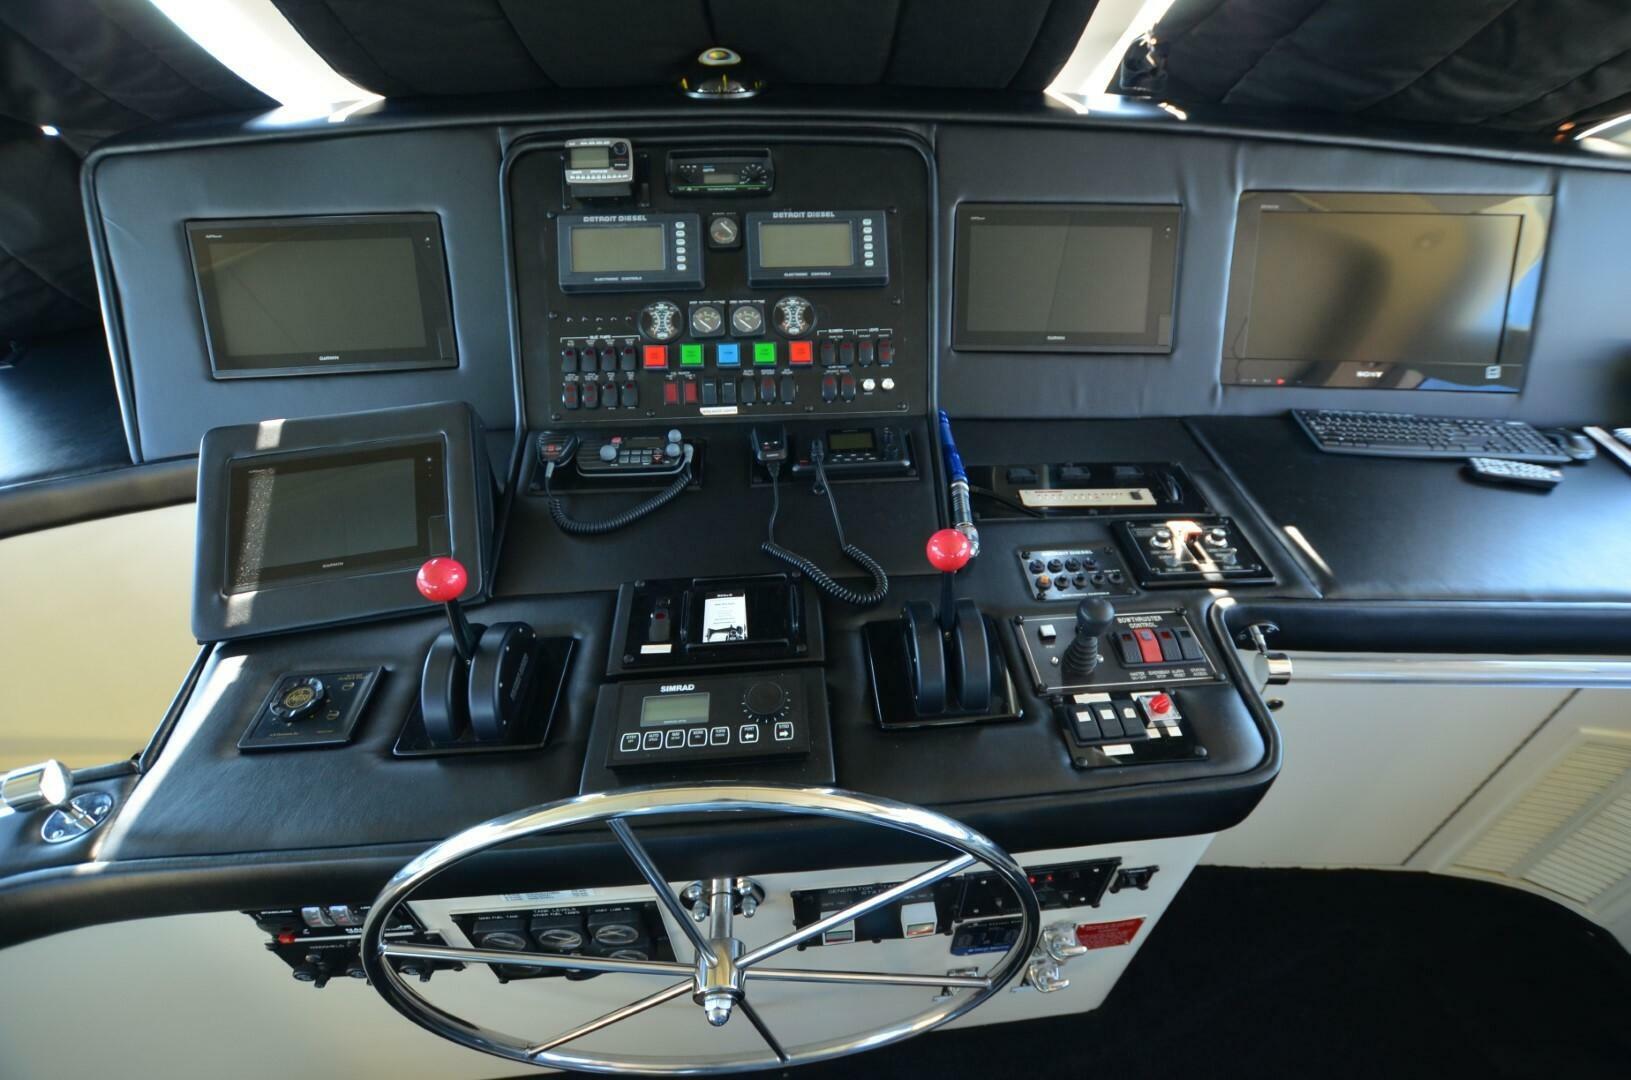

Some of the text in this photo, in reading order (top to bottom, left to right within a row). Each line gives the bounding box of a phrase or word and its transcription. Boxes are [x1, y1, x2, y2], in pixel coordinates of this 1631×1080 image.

[583, 214, 647, 223] DETROIT DIESEL
[772, 211, 805, 219] DETROIT
[1116, 615, 1163, 624] BOWTHRUSTER
[660, 683, 695, 693] SIMRAD
